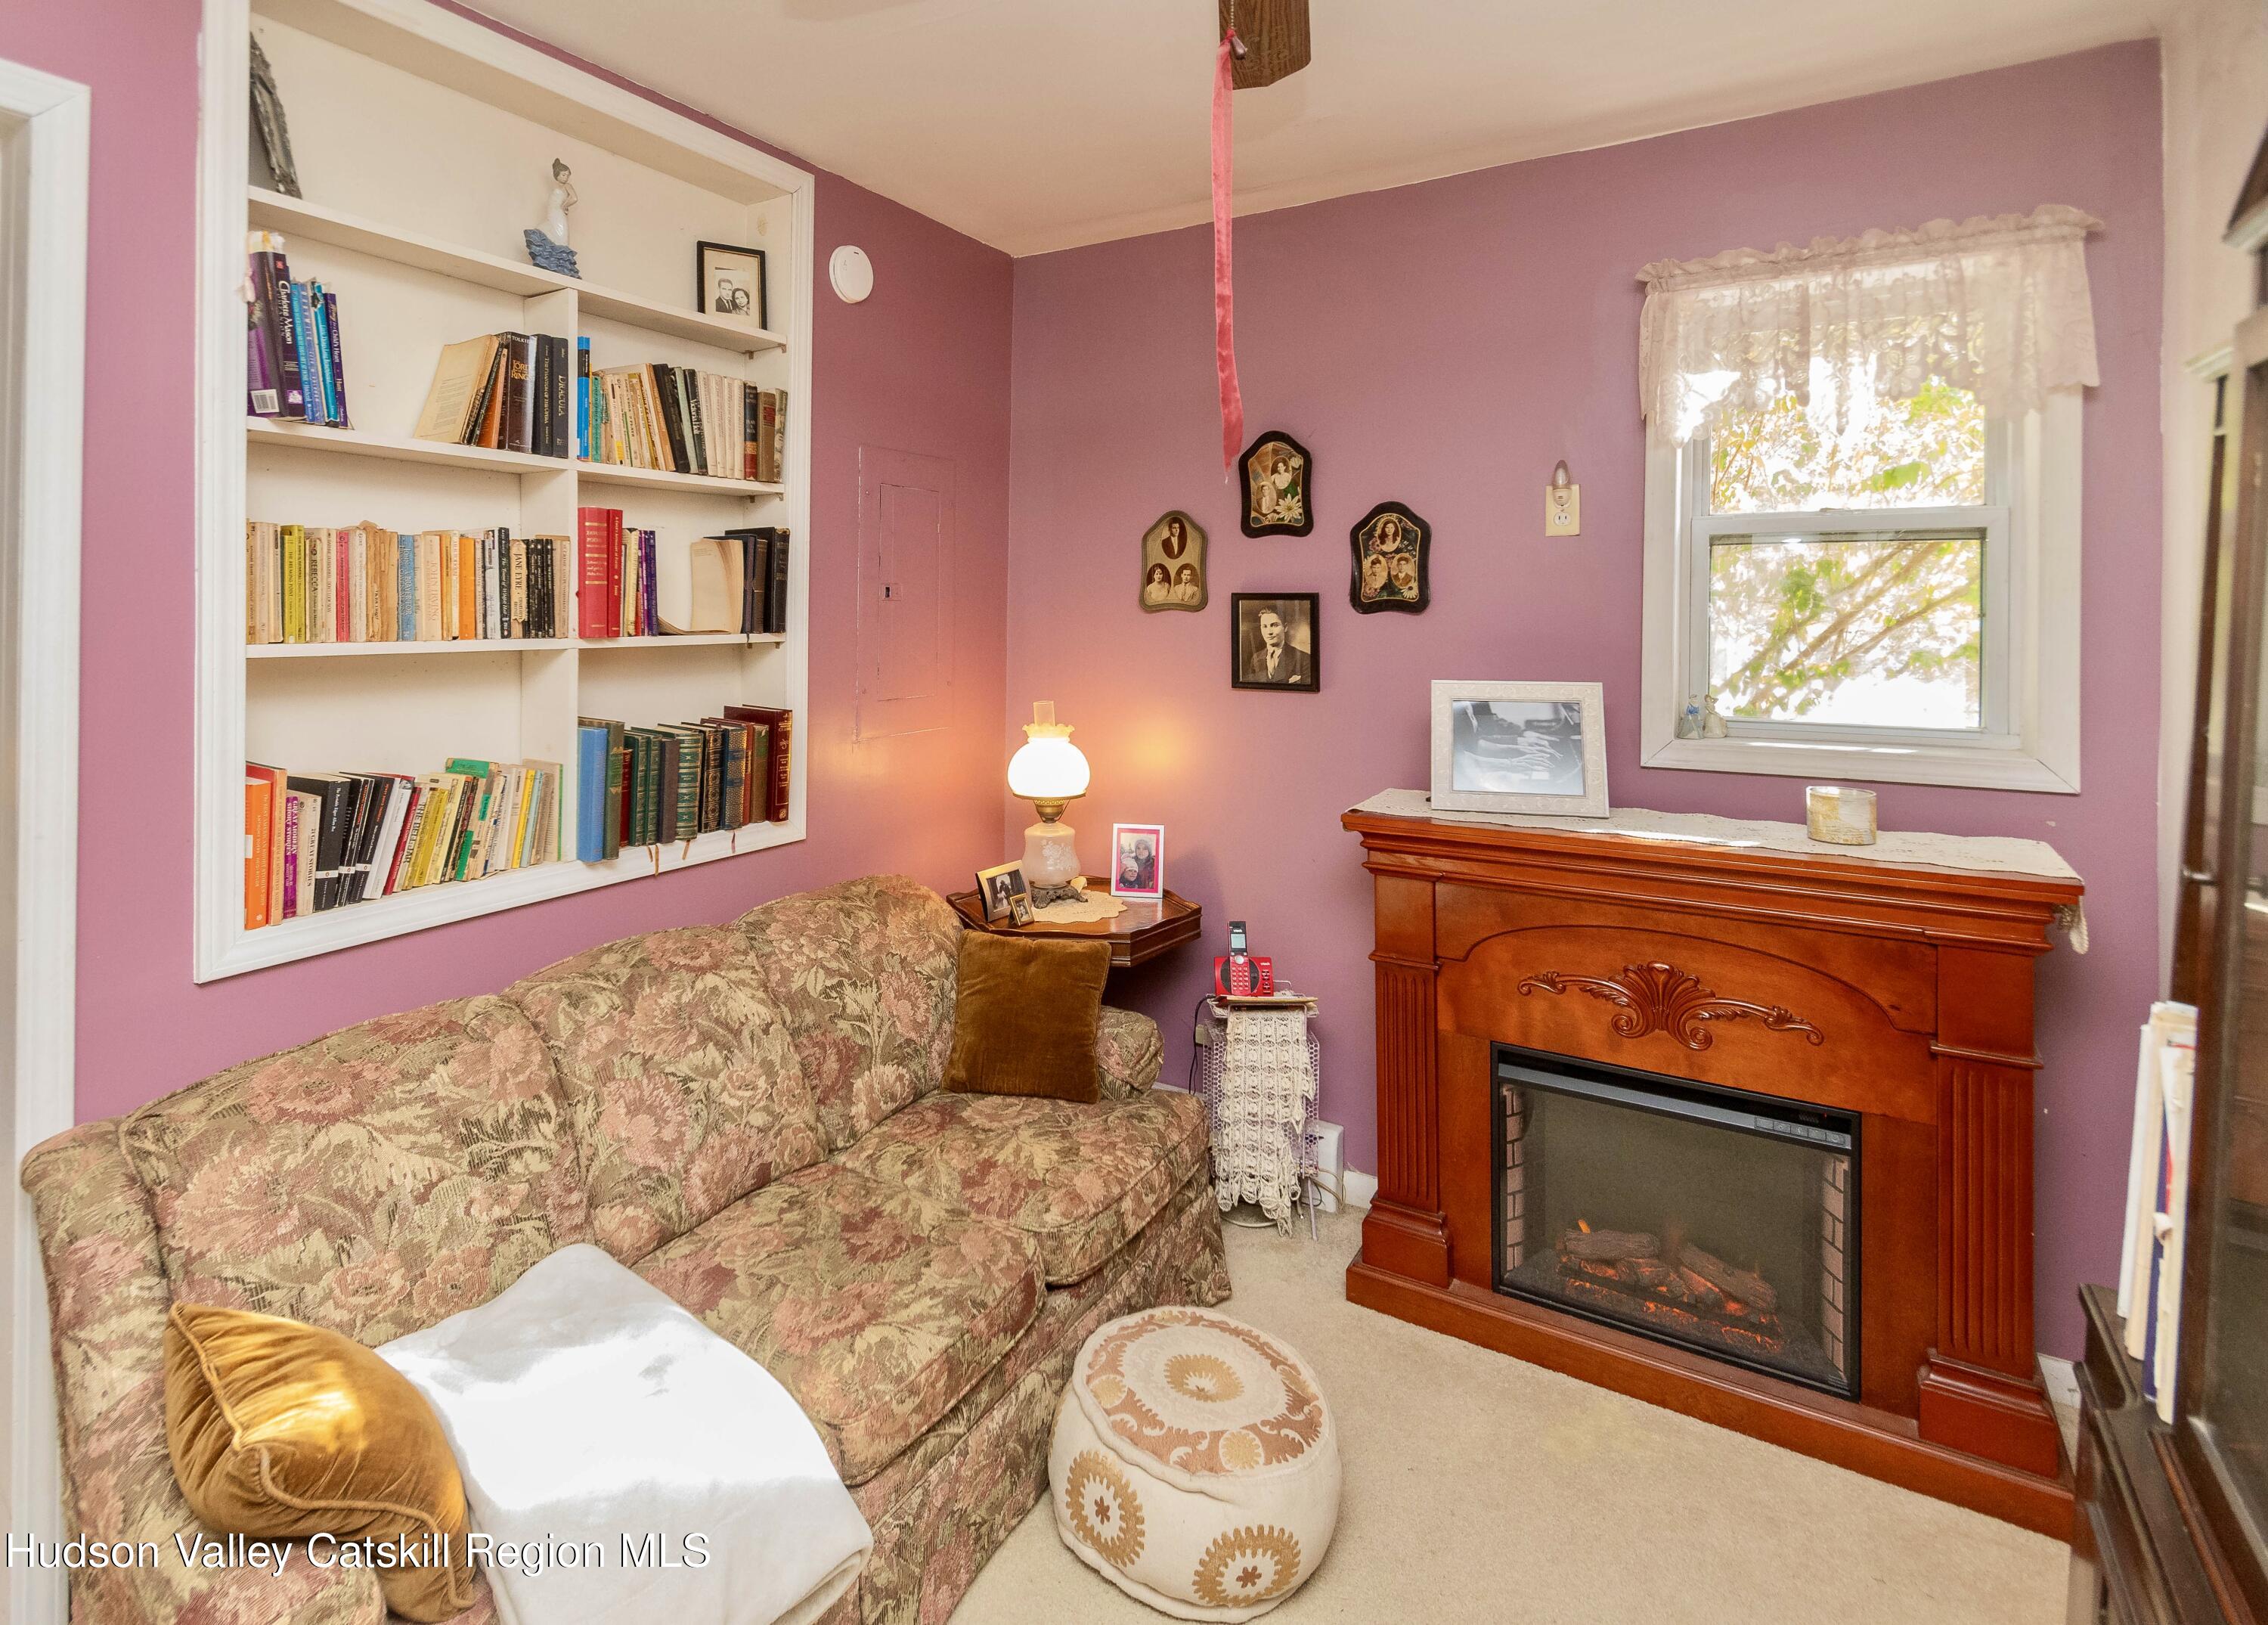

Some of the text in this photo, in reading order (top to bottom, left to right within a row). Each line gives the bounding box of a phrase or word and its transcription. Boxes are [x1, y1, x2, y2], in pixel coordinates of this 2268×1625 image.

[278, 280, 293, 345] Charlotte Mason
[331, 328, 339, 348] Child's
[557, 374, 566, 417] DRACULA
[690, 399, 699, 421] Victoria
[692, 421, 701, 434] Holt
[513, 552, 522, 569] JANE
[514, 572, 522, 590] EYRE
[414, 801, 426, 822] THE
[407, 820, 420, 845] BELL
[395, 850, 404, 866] CHARLES
[403, 845, 414, 865] JAR
[306, 857, 314, 888] STORIES
[391, 864, 399, 881] DICKENS
